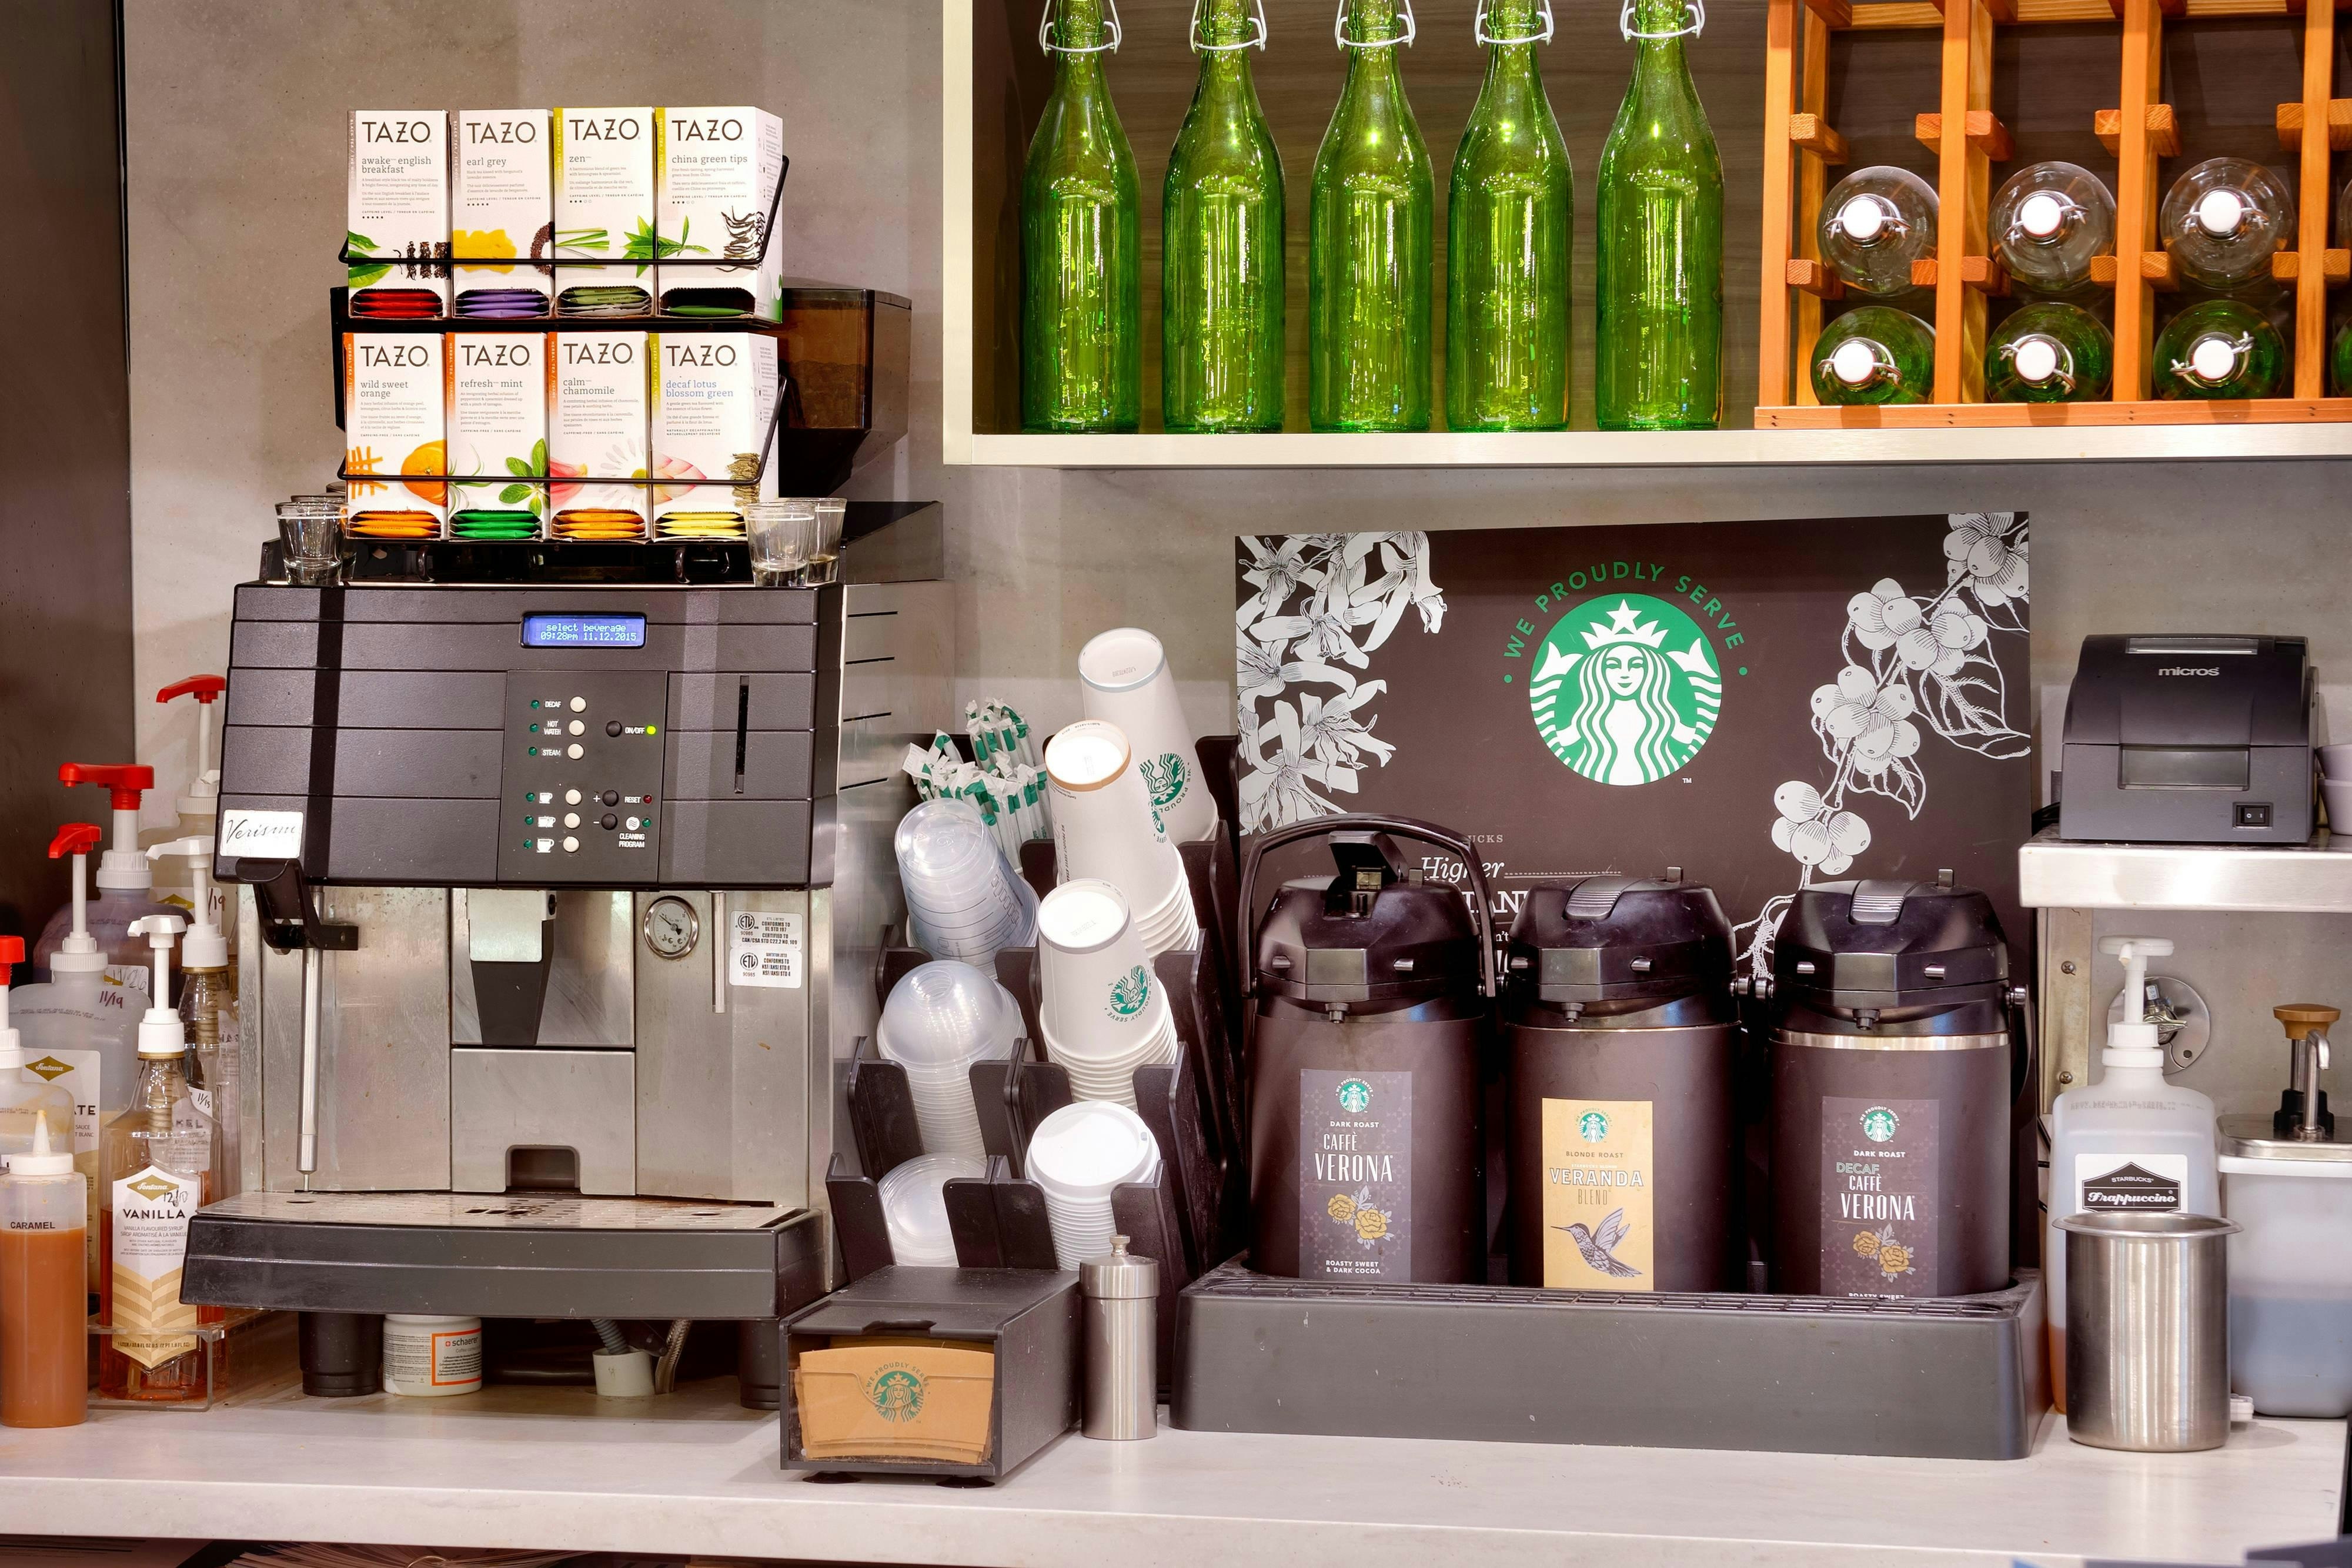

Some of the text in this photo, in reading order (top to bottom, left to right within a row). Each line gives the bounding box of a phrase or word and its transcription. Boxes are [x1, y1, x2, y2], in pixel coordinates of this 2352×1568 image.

[362, 121, 430, 143] TAZO
[466, 122, 536, 143] TAZO
[569, 118, 639, 141] TAZO
[671, 119, 743, 141] TAZO
[362, 156, 431, 166] awake english
[466, 157, 507, 168] earl grey
[671, 154, 747, 165] china green tips
[362, 165, 404, 173] breakfast
[360, 346, 428, 367] TAZO
[461, 345, 530, 366] TAZO
[563, 343, 633, 364] TAZO
[666, 345, 736, 366] TAZO
[460, 379, 523, 387] refresh mint
[563, 387, 615, 395] chamomile
[707, 390, 733, 399] green
[1504, 561, 1745, 657] WE PROUDLY SERVE
[583, 623, 626, 631] beverage
[583, 632, 636, 641] 11.12.2015
[2159, 667, 2220, 676] micros
[1159, 787, 1188, 813] PROUDL
[35, 1062, 64, 1072] Fontana
[1362, 1080, 1374, 1092] SERVE
[1865, 1106, 1887, 1115] PROUDLY
[1887, 1109, 1899, 1122] SERVE
[1324, 1132, 1358, 1151] CAFFÈ
[1315, 1153, 1393, 1182] VERONA
[1836, 1162, 1879, 1175] DECAF
[1549, 1168, 1644, 1186] VERANDA
[1849, 1174, 1882, 1192] CAFFÈ
[1578, 1189, 1608, 1205] BLEND
[2087, 1191, 2177, 1205] Frappuccino
[123, 1209, 185, 1219] VANILLA
[1840, 1192, 1915, 1221] VERONA
[10, 1221, 55, 1229] CARAMEL
[452, 1336, 479, 1346] schaerer
[866, 1362, 930, 1388] WE PROUDLY SERVE
